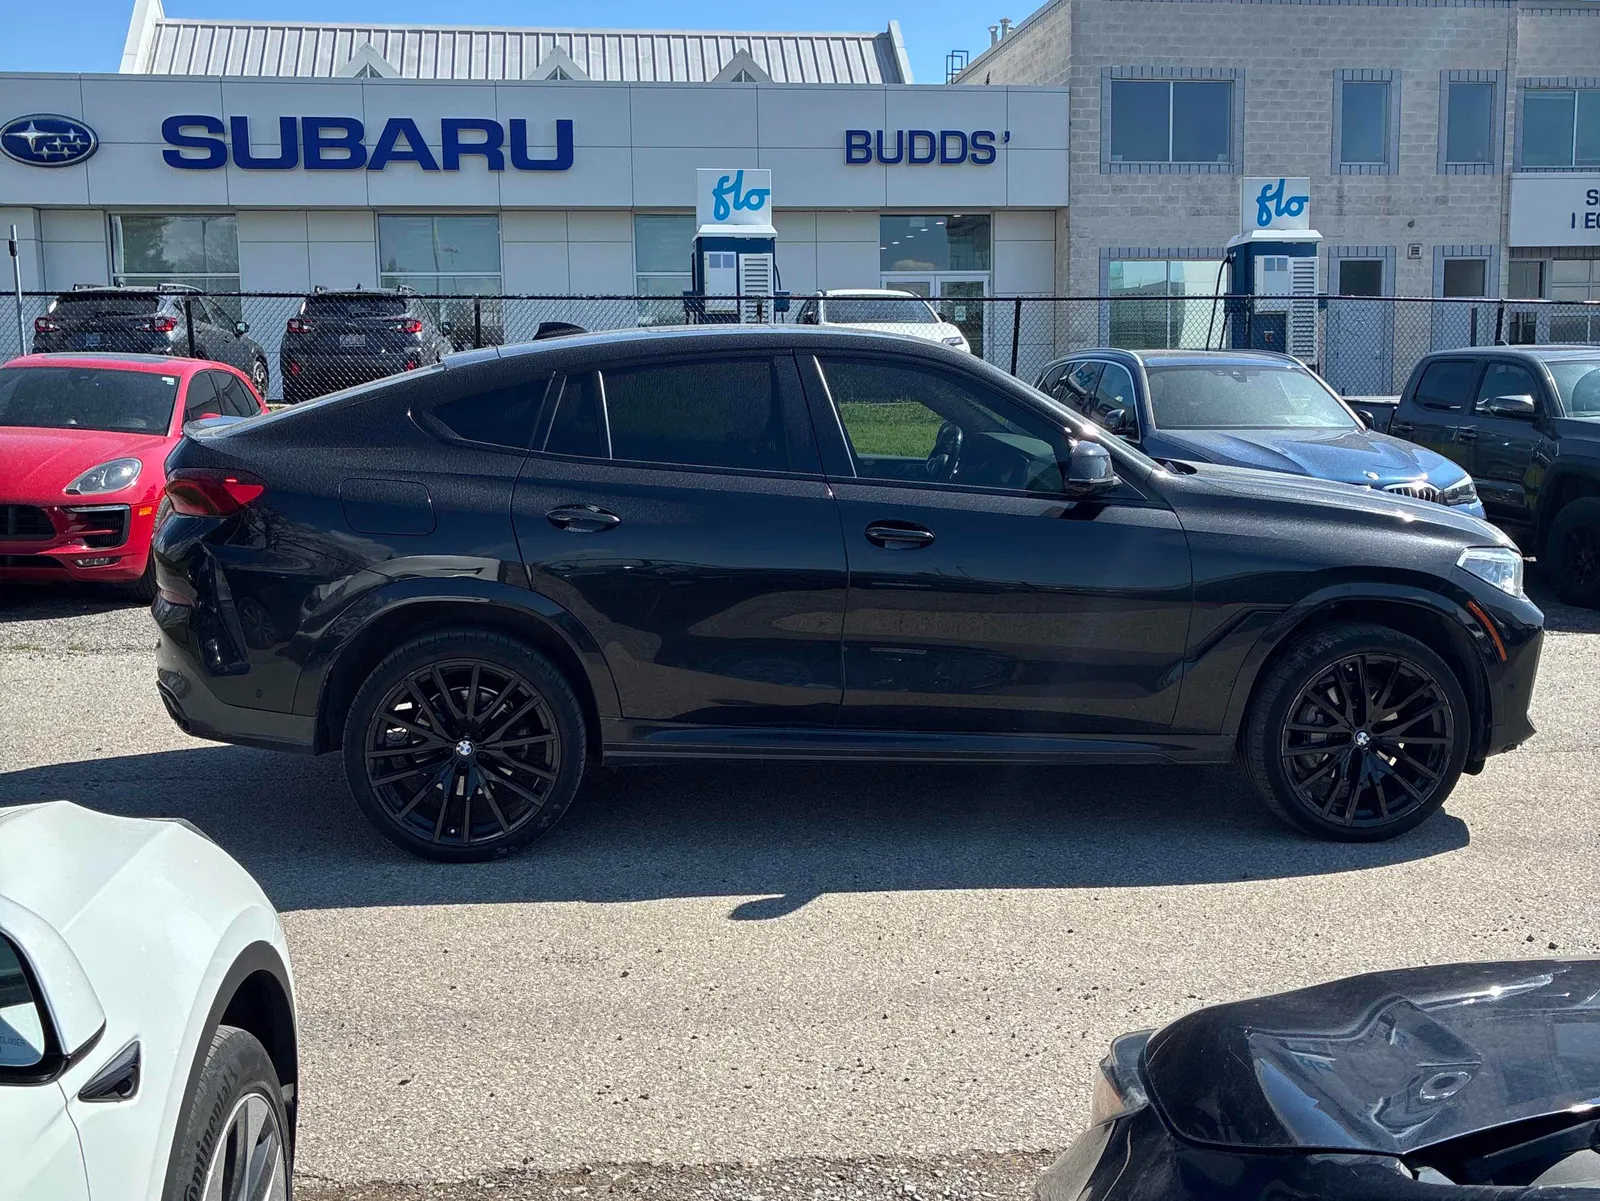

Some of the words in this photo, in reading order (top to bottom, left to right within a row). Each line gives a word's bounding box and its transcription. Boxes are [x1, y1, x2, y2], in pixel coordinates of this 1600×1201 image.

[161, 114, 573, 171] SUBARU
[845, 130, 1010, 164] BUDDS'
[712, 169, 771, 221] flo
[1256, 178, 1310, 227] flo
[1586, 189, 1600, 206] S
